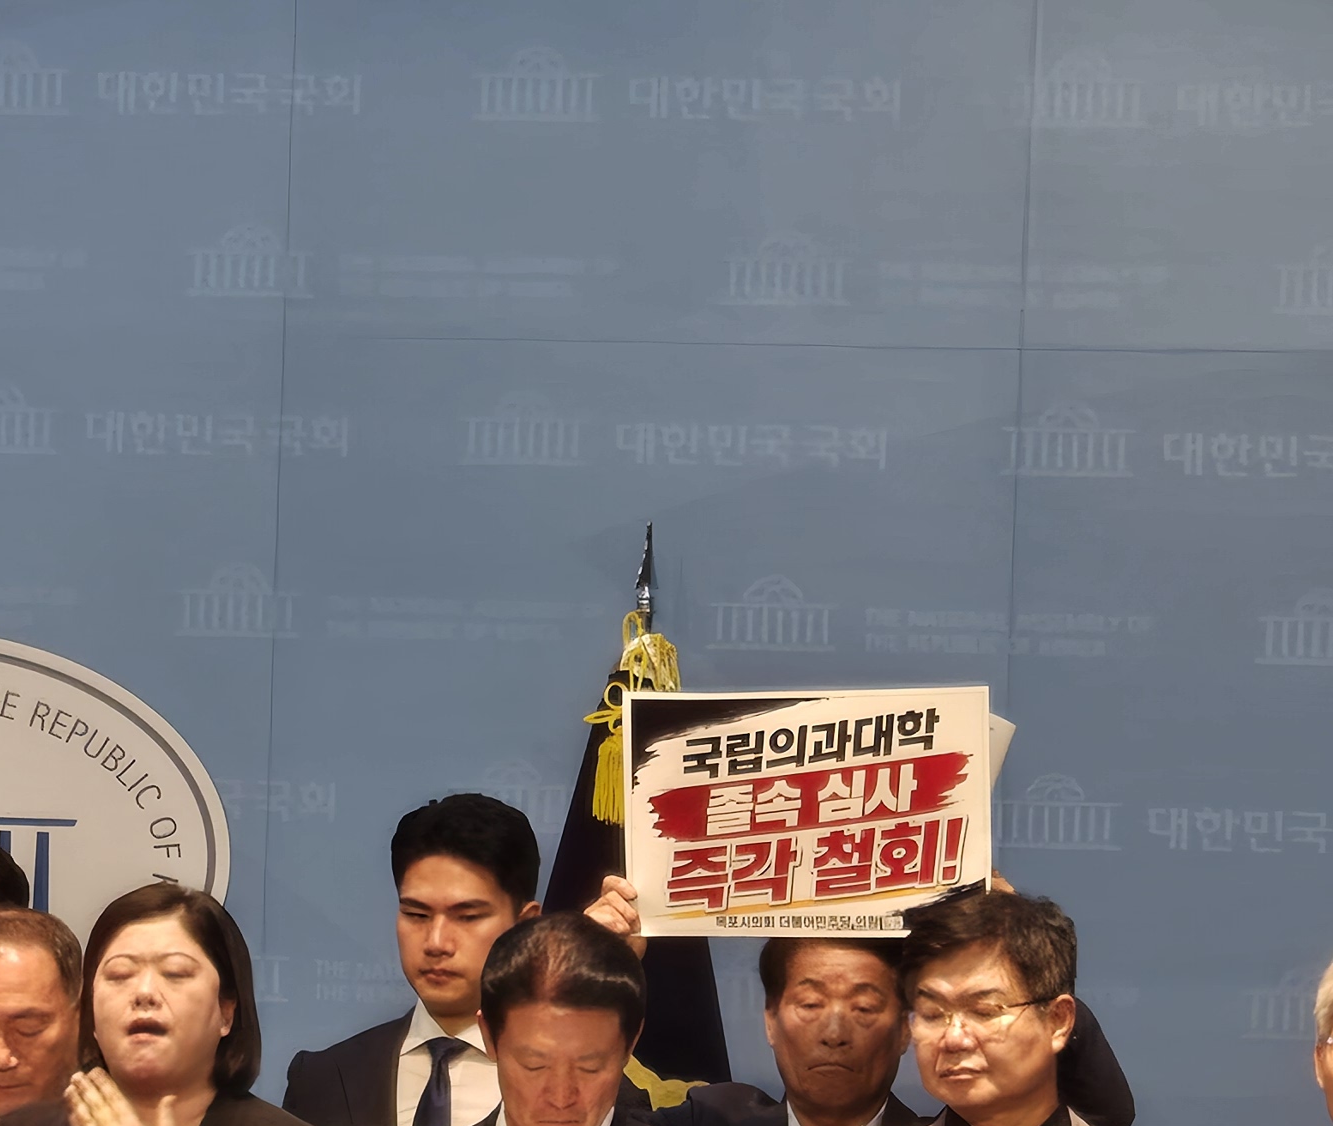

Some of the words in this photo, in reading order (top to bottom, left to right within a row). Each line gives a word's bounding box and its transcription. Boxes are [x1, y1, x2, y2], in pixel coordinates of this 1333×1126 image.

[683, 708, 939, 778] 국립의과대학
[29, 700, 163, 811] REPUBLIC
[149, 816, 183, 861] OF
[707, 779, 803, 832] 졸속
[817, 763, 918, 818] 심사
[667, 838, 799, 908] 즉각
[813, 816, 966, 898] 철회!
[1147, 806, 1333, 854] 대한민국
